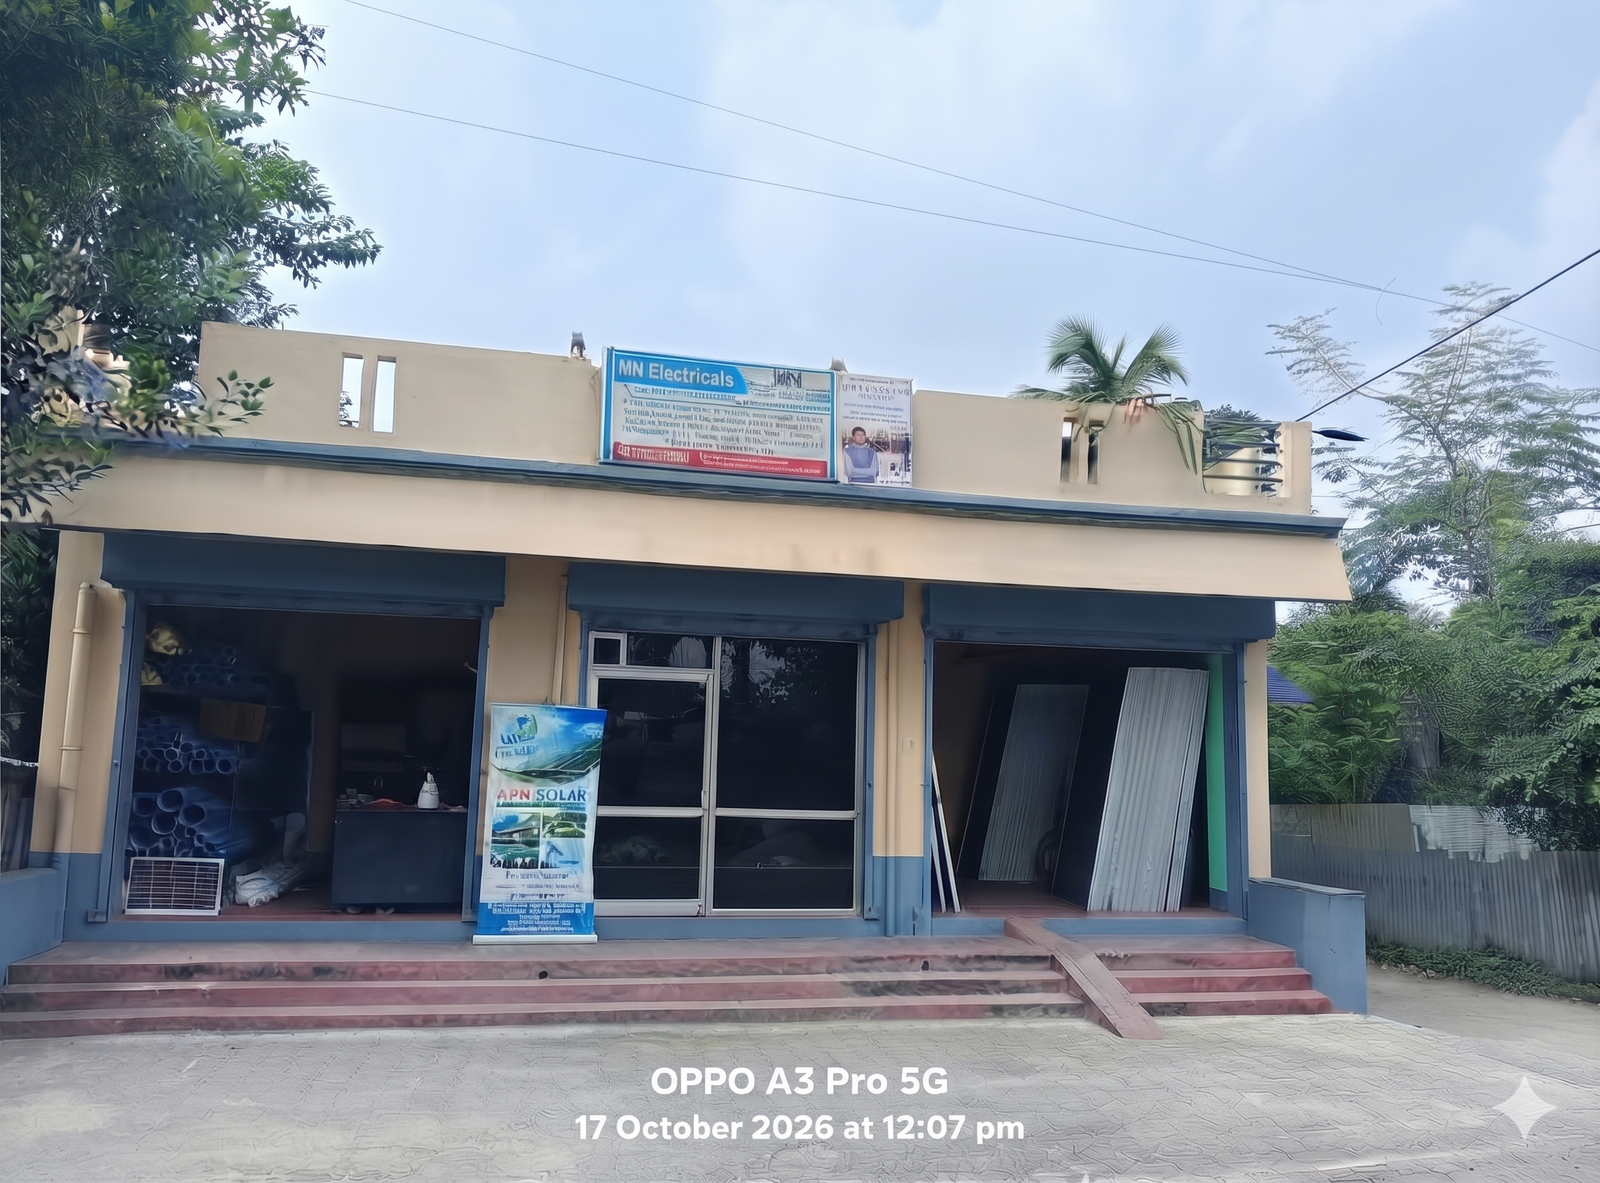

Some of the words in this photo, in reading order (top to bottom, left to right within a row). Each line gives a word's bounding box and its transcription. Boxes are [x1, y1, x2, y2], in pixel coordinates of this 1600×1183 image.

[618, 359, 644, 378] MN
[648, 362, 735, 388] Electricals
[497, 788, 530, 801] APN
[536, 788, 587, 802] SOLAR
